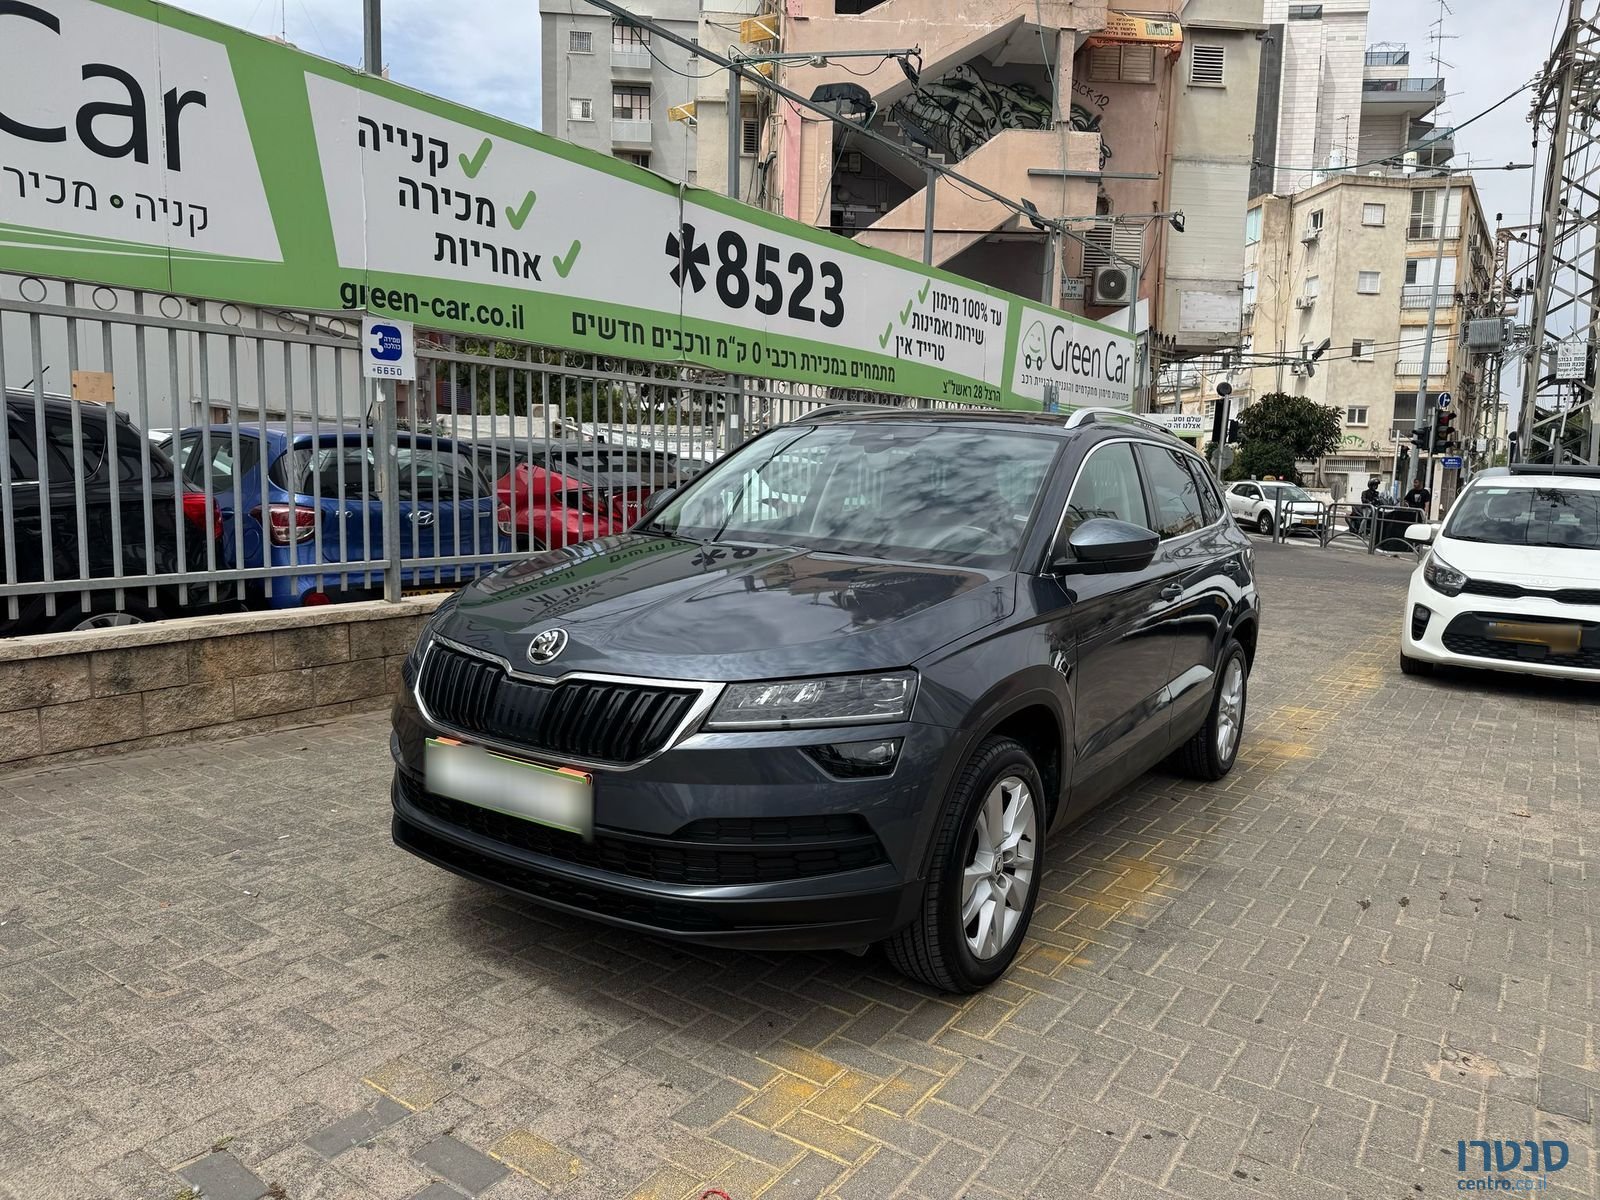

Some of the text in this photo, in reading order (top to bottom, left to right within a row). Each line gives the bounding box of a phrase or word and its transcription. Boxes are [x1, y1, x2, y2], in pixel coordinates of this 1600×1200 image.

[358, 115, 449, 177] קנייה
[135, 192, 208, 238] קניה
[398, 176, 496, 228] מכירה
[434, 231, 542, 282] אחריות
[340, 281, 524, 330] green-car.co.il
[932, 290, 1002, 326] עד 100% מימון
[572, 311, 645, 345] חדשים
[652, 326, 710, 355] ורכבים
[911, 311, 984, 345] שירות ואמינות
[752, 341, 762, 364] 0
[766, 347, 797, 370] רכבי
[801, 353, 847, 376] במכירת
[895, 335, 945, 362] טרייד אין
[1050, 324, 1131, 385] Green Car
[851, 360, 896, 383] מתמחים
[973, 384, 983, 399] 28
[984, 385, 1001, 402] הרצל
